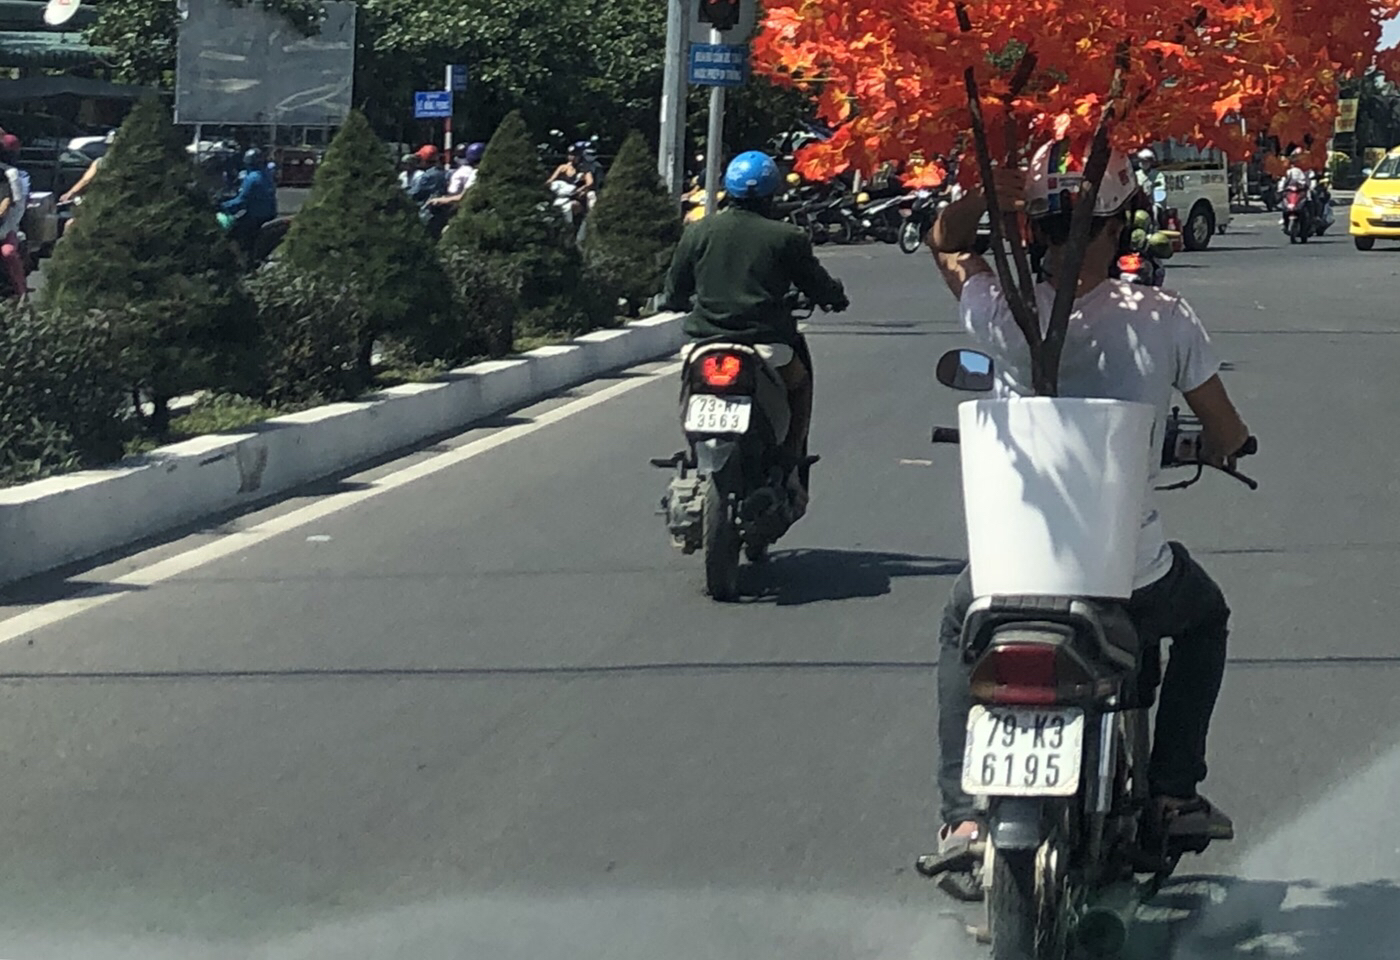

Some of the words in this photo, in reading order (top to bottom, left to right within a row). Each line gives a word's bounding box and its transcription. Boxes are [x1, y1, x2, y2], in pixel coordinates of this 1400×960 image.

[697, 414, 739, 428] 3563
[985, 714, 1065, 749] 79-K3
[981, 751, 1061, 787] 6195
